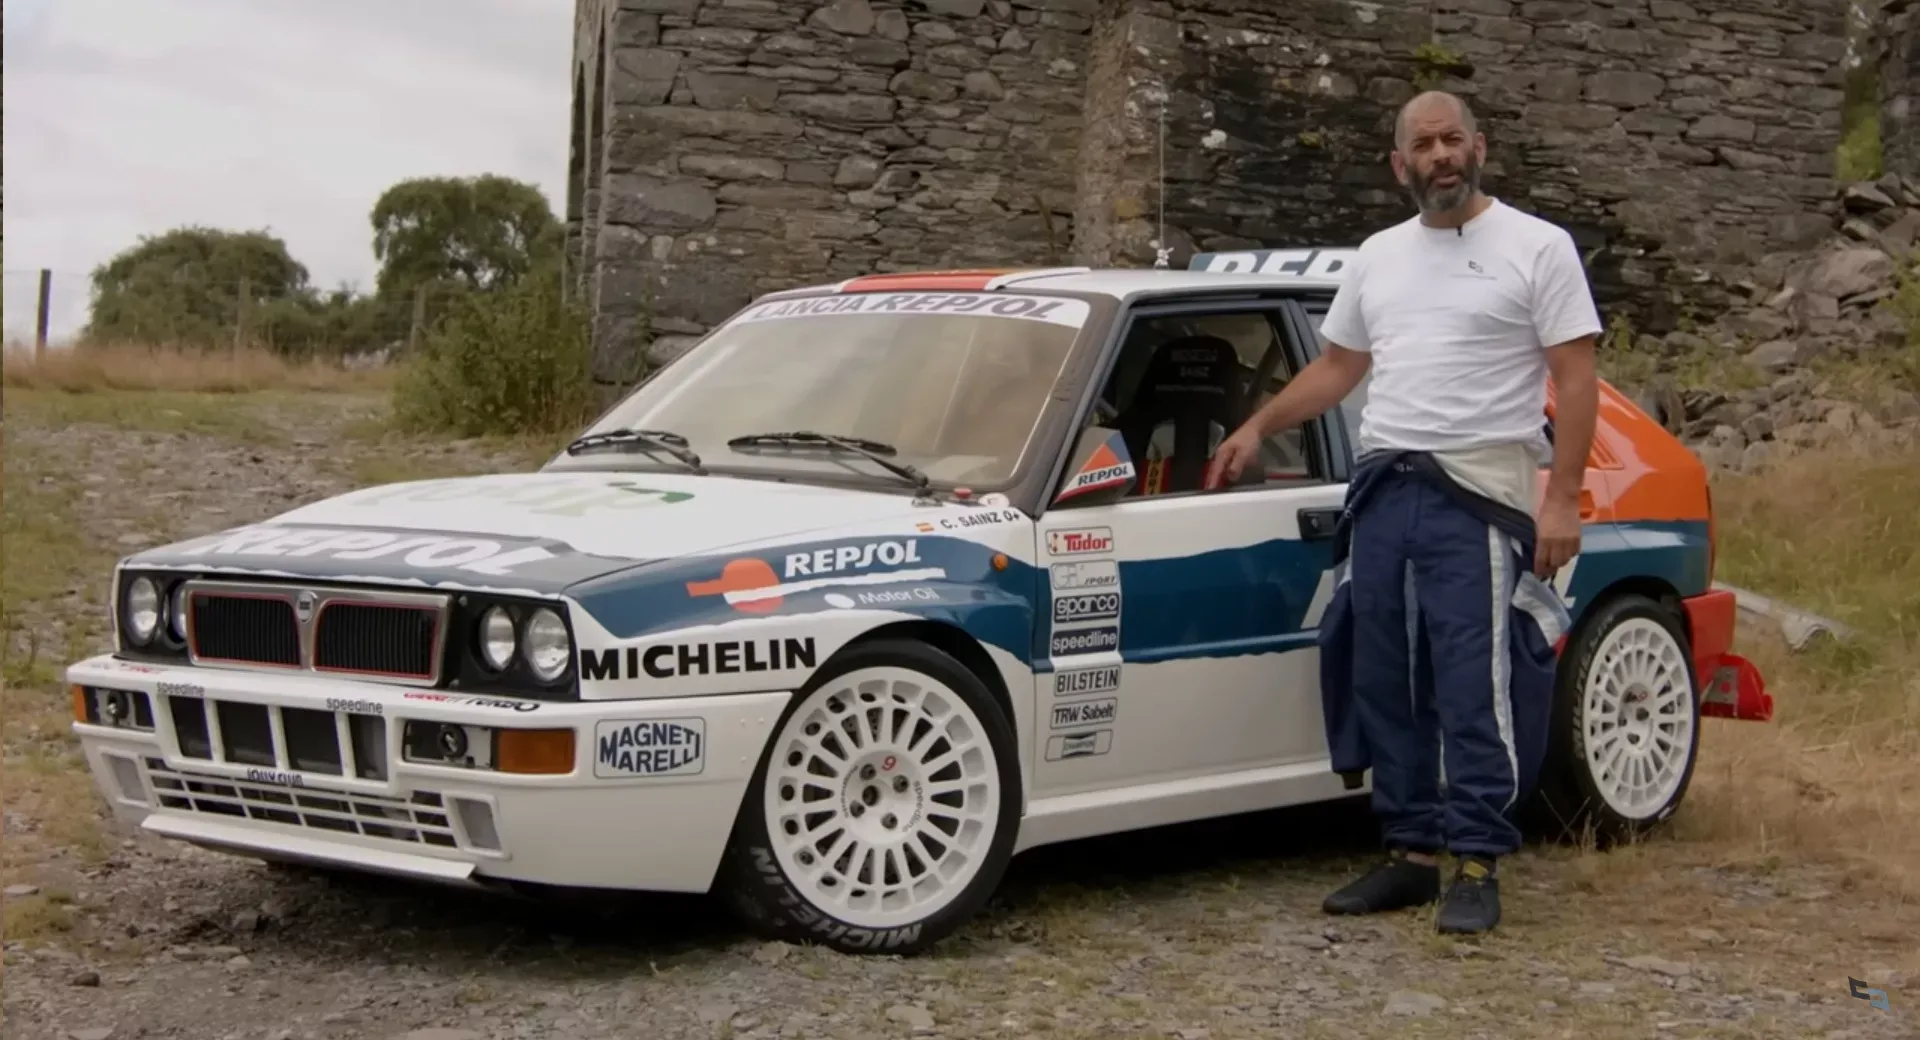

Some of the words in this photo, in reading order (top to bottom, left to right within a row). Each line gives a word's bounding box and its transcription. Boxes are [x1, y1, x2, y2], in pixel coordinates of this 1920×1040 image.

[752, 296, 864, 319] LANCIA
[869, 294, 1063, 318] REPSOL
[1078, 465, 1128, 486] REPSOL
[940, 519, 957, 529] C.
[959, 511, 1002, 527] SAINZ
[182, 526, 557, 575] REPSOL
[1063, 532, 1112, 552] Tudor
[784, 539, 921, 578] REPSOL
[858, 589, 911, 605] Motor
[913, 587, 940, 600] Oil
[1056, 595, 1118, 620] sparco
[1052, 632, 1117, 655] speedline
[580, 637, 816, 681] MICHELIN
[156, 682, 205, 696] speedline
[1056, 669, 1119, 693] BILSTEIN
[326, 697, 384, 714] speedline
[1054, 707, 1080, 724] TRW
[1081, 703, 1114, 721] Sabelt
[881, 755, 897, 771] 9
